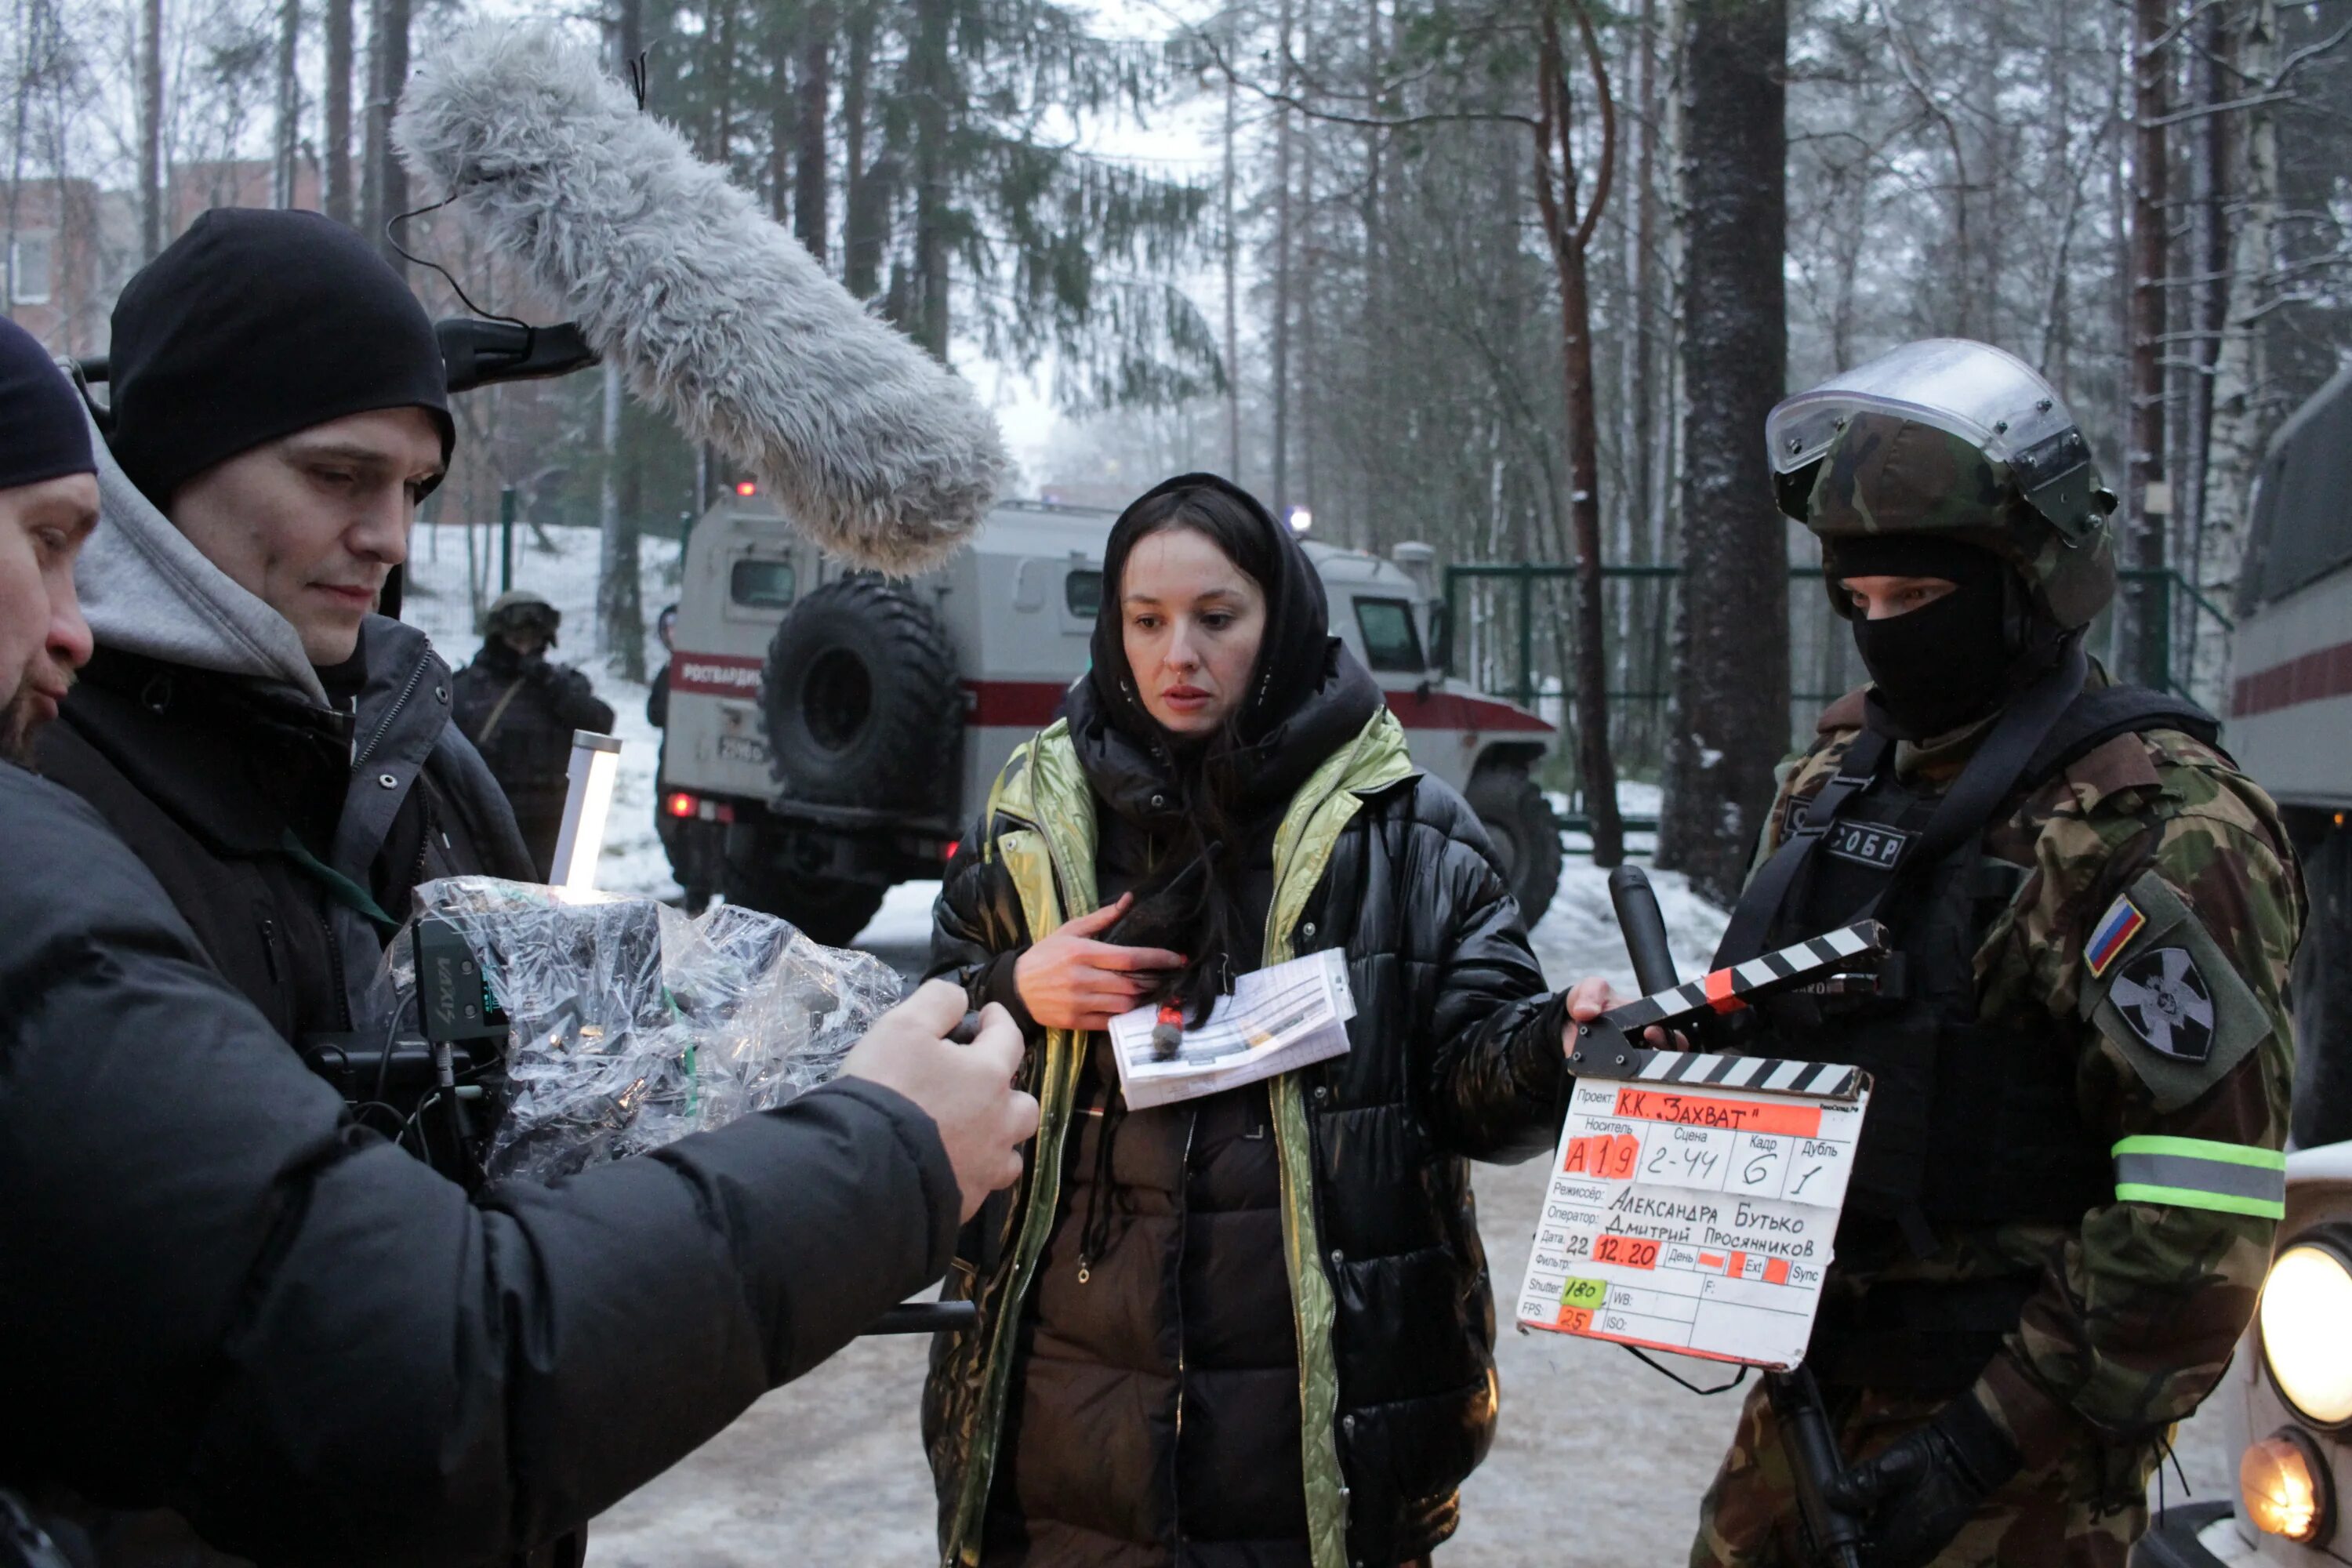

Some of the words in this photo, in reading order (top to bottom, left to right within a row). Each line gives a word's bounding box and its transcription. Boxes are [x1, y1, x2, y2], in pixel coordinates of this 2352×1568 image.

[1577, 1088, 1615, 1105] Проект:
[1585, 1117, 1633, 1134] Носитель
[1674, 1127, 1708, 1143] Сцена
[1750, 1135, 1777, 1151] Кадр
[1802, 1140, 1838, 1157] Дубль
[1553, 1181, 1605, 1202] Режиссёр:
[1548, 1205, 1599, 1226] Оператор:
[1566, 1235, 1589, 1256] 22
[1535, 1254, 1571, 1271] Фильтр:
[1668, 1248, 1693, 1264] День
[1744, 1259, 1762, 1273] Ext
[1793, 1265, 1819, 1282] Sync
[1565, 1279, 1596, 1298] 180
[1704, 1280, 1715, 1294] F:
[1613, 1291, 1633, 1306] WB:
[1522, 1301, 1544, 1316] FPS:
[1559, 1308, 1588, 1330] 25
[1607, 1317, 1627, 1331] ISO:
